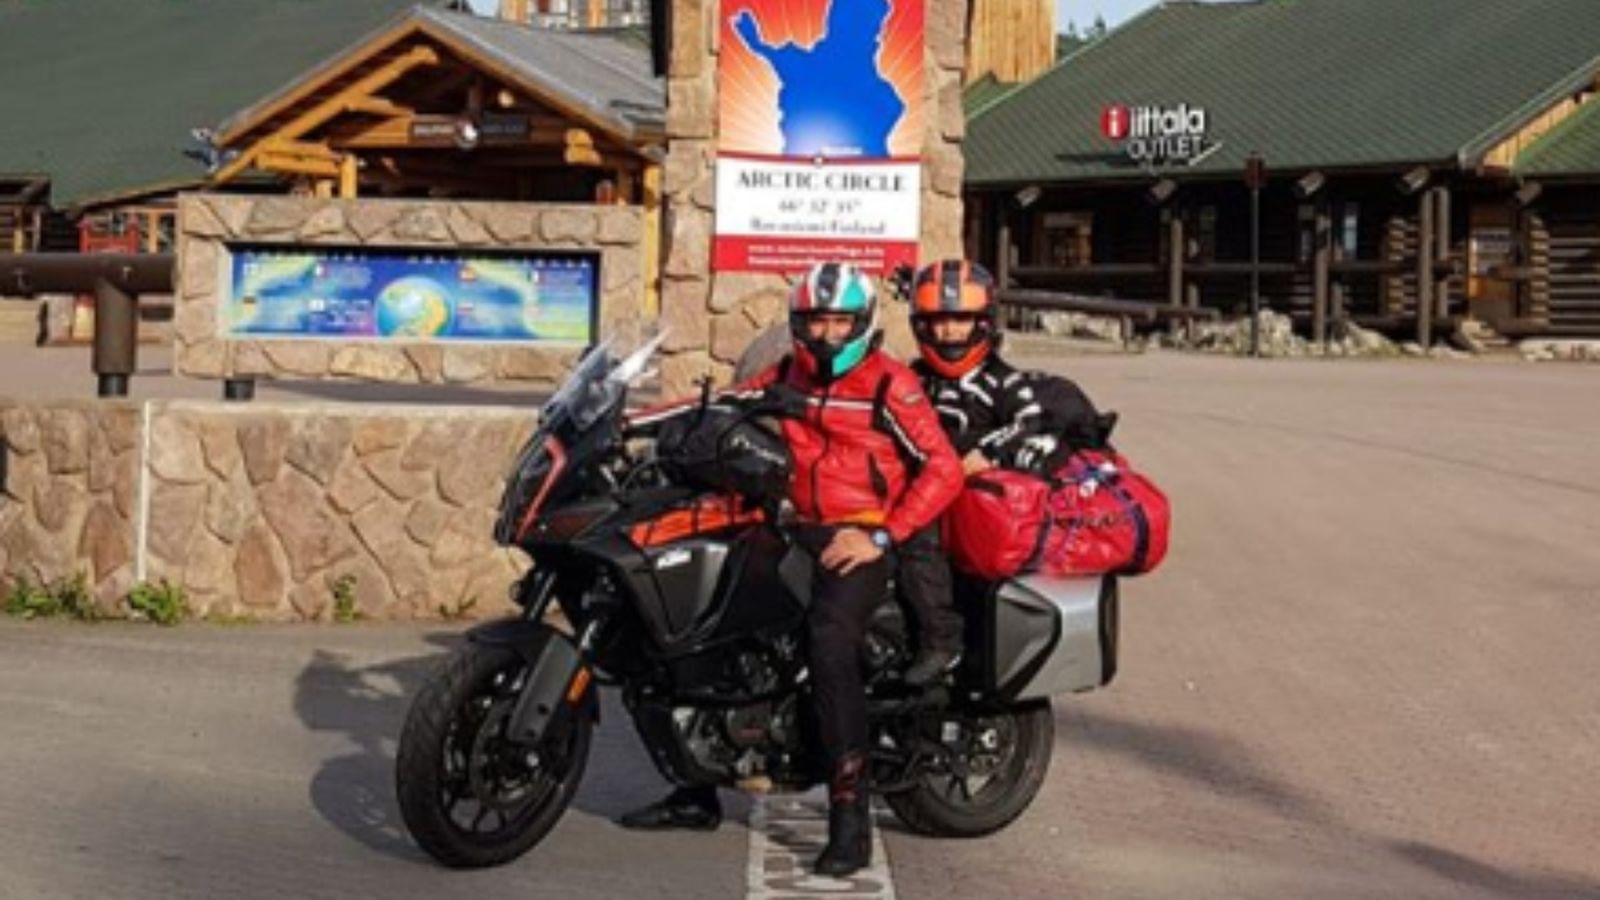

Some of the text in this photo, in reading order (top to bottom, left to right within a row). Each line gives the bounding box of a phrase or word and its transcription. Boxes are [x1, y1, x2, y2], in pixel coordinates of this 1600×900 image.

[1130, 103, 1205, 136] iittala
[1127, 136, 1202, 159] OUTLET
[736, 169, 907, 193] ARCTIC CIRCLE
